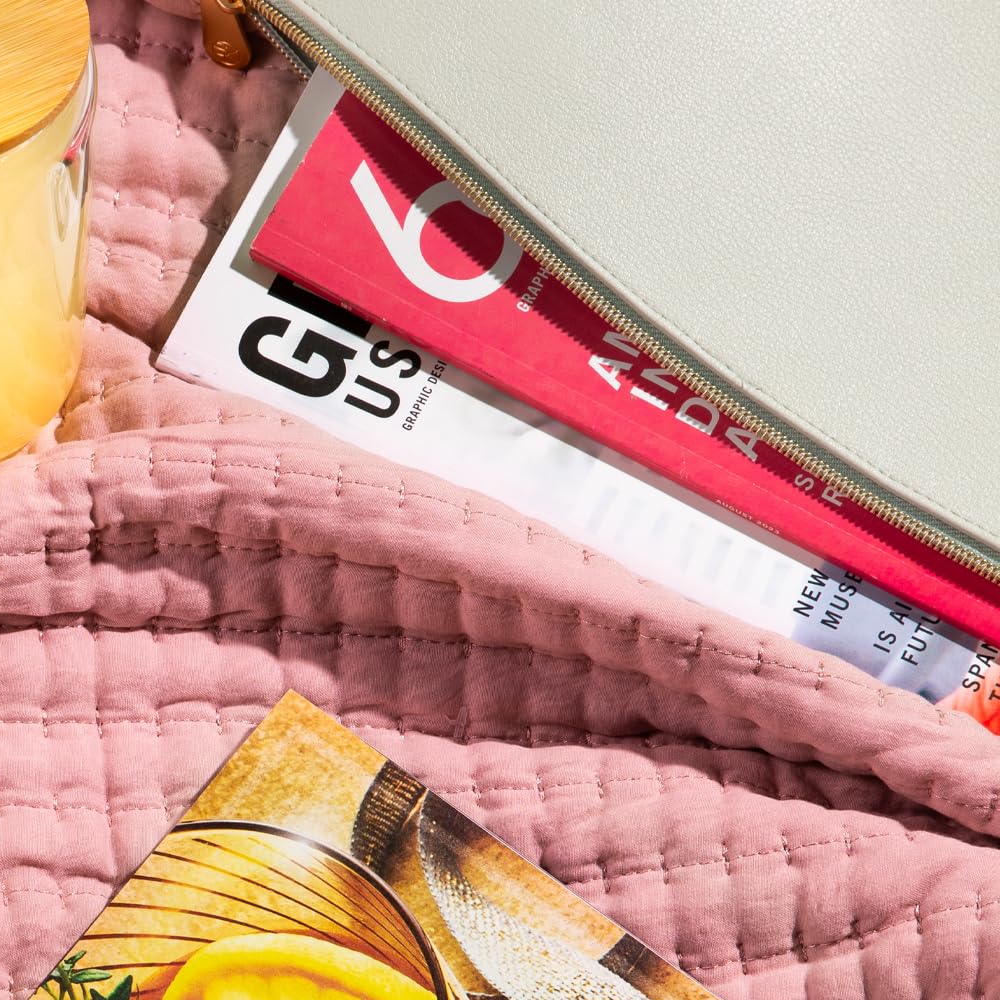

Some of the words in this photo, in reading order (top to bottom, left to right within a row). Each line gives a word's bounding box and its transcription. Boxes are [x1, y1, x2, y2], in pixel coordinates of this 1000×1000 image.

[402, 384, 433, 431] GRAPHIC
[793, 568, 830, 618] NEW
[873, 630, 897, 654] IS
